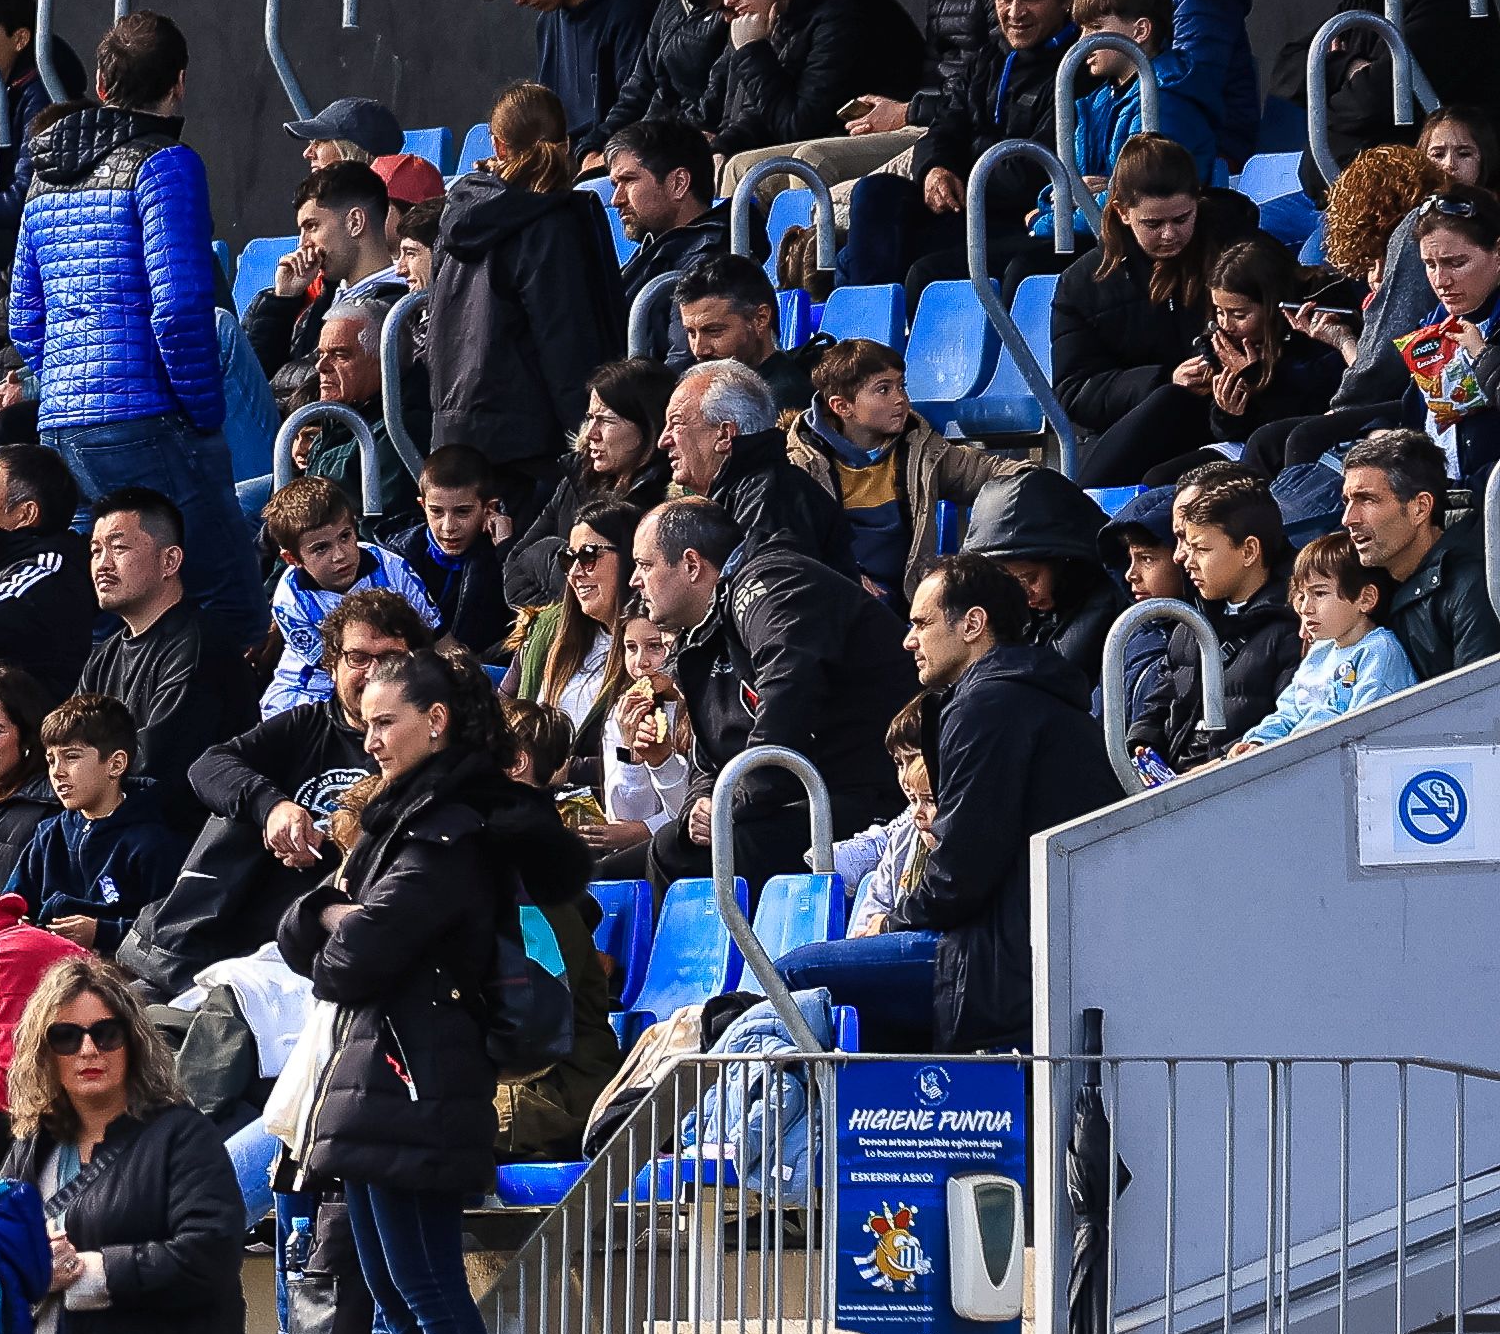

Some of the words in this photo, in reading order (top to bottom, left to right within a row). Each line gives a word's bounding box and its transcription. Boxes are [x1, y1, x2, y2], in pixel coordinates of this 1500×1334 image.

[848, 1108, 935, 1131] HIGIENE
[938, 1109, 1014, 1132] PUNTUA
[850, 1172, 902, 1183] ESKERRIK
